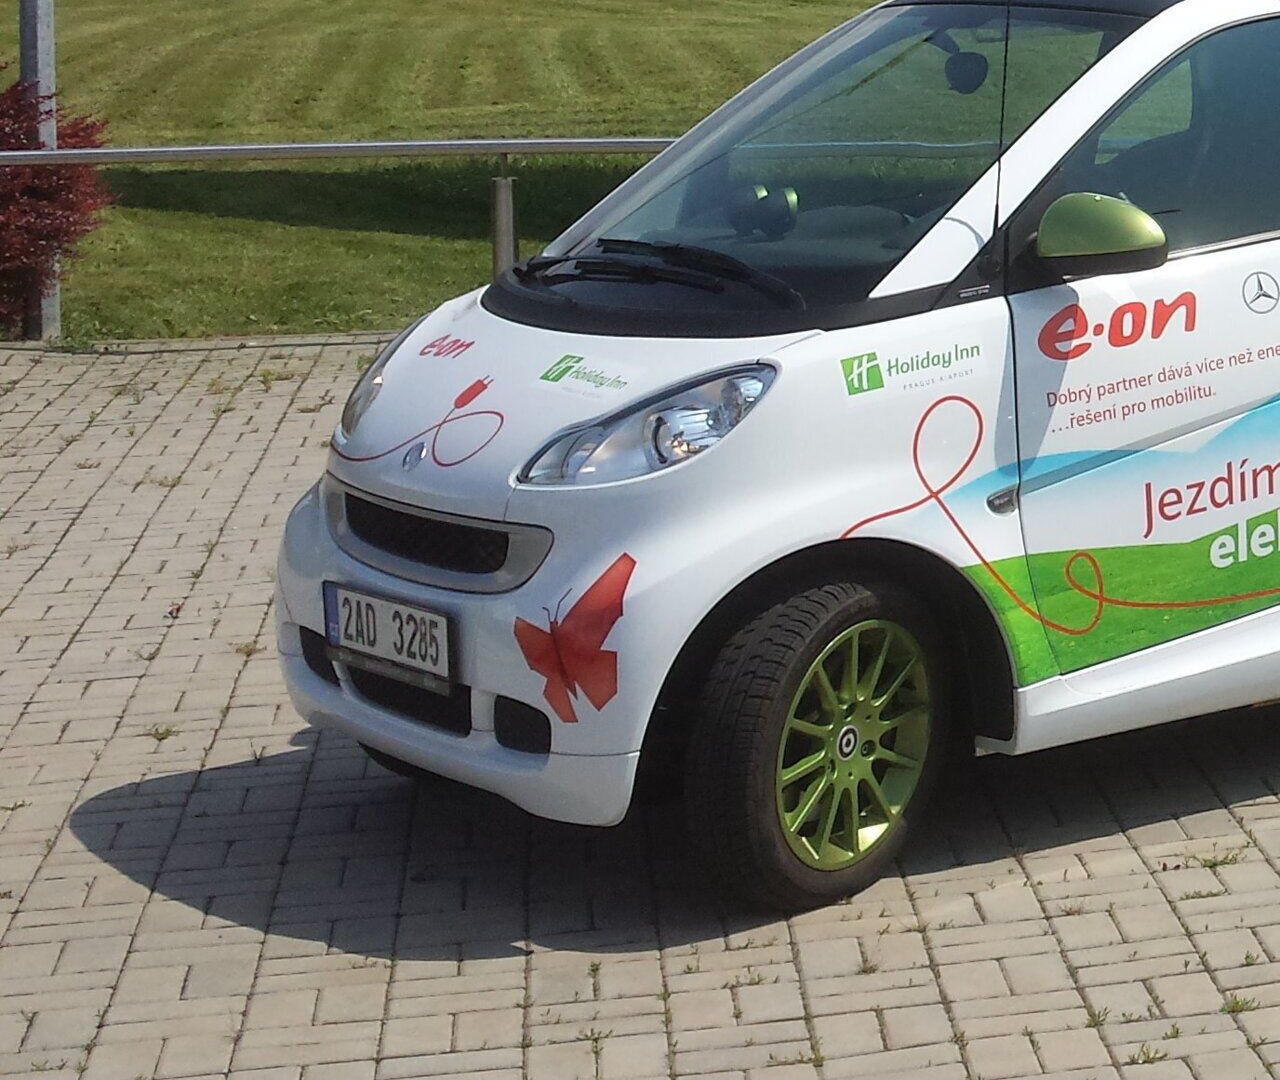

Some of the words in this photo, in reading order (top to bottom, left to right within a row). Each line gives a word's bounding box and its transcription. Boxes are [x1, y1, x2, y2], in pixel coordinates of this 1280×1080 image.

[568, 365, 610, 388] Holiday
[606, 374, 628, 390] Inn
[887, 351, 952, 377] Holiday
[955, 344, 981, 361] Inn
[903, 378, 936, 390] PRAGUE
[1046, 384, 1092, 410] Dobrý
[1097, 373, 1153, 401] partner
[1158, 363, 1193, 383] dává
[1196, 357, 1225, 374] více
[1229, 349, 1254, 367] než
[1122, 401, 1147, 421] pro
[1151, 383, 1217, 410] mobilitu.
[342, 597, 377, 648] 2AD
[392, 610, 439, 667] 3285
